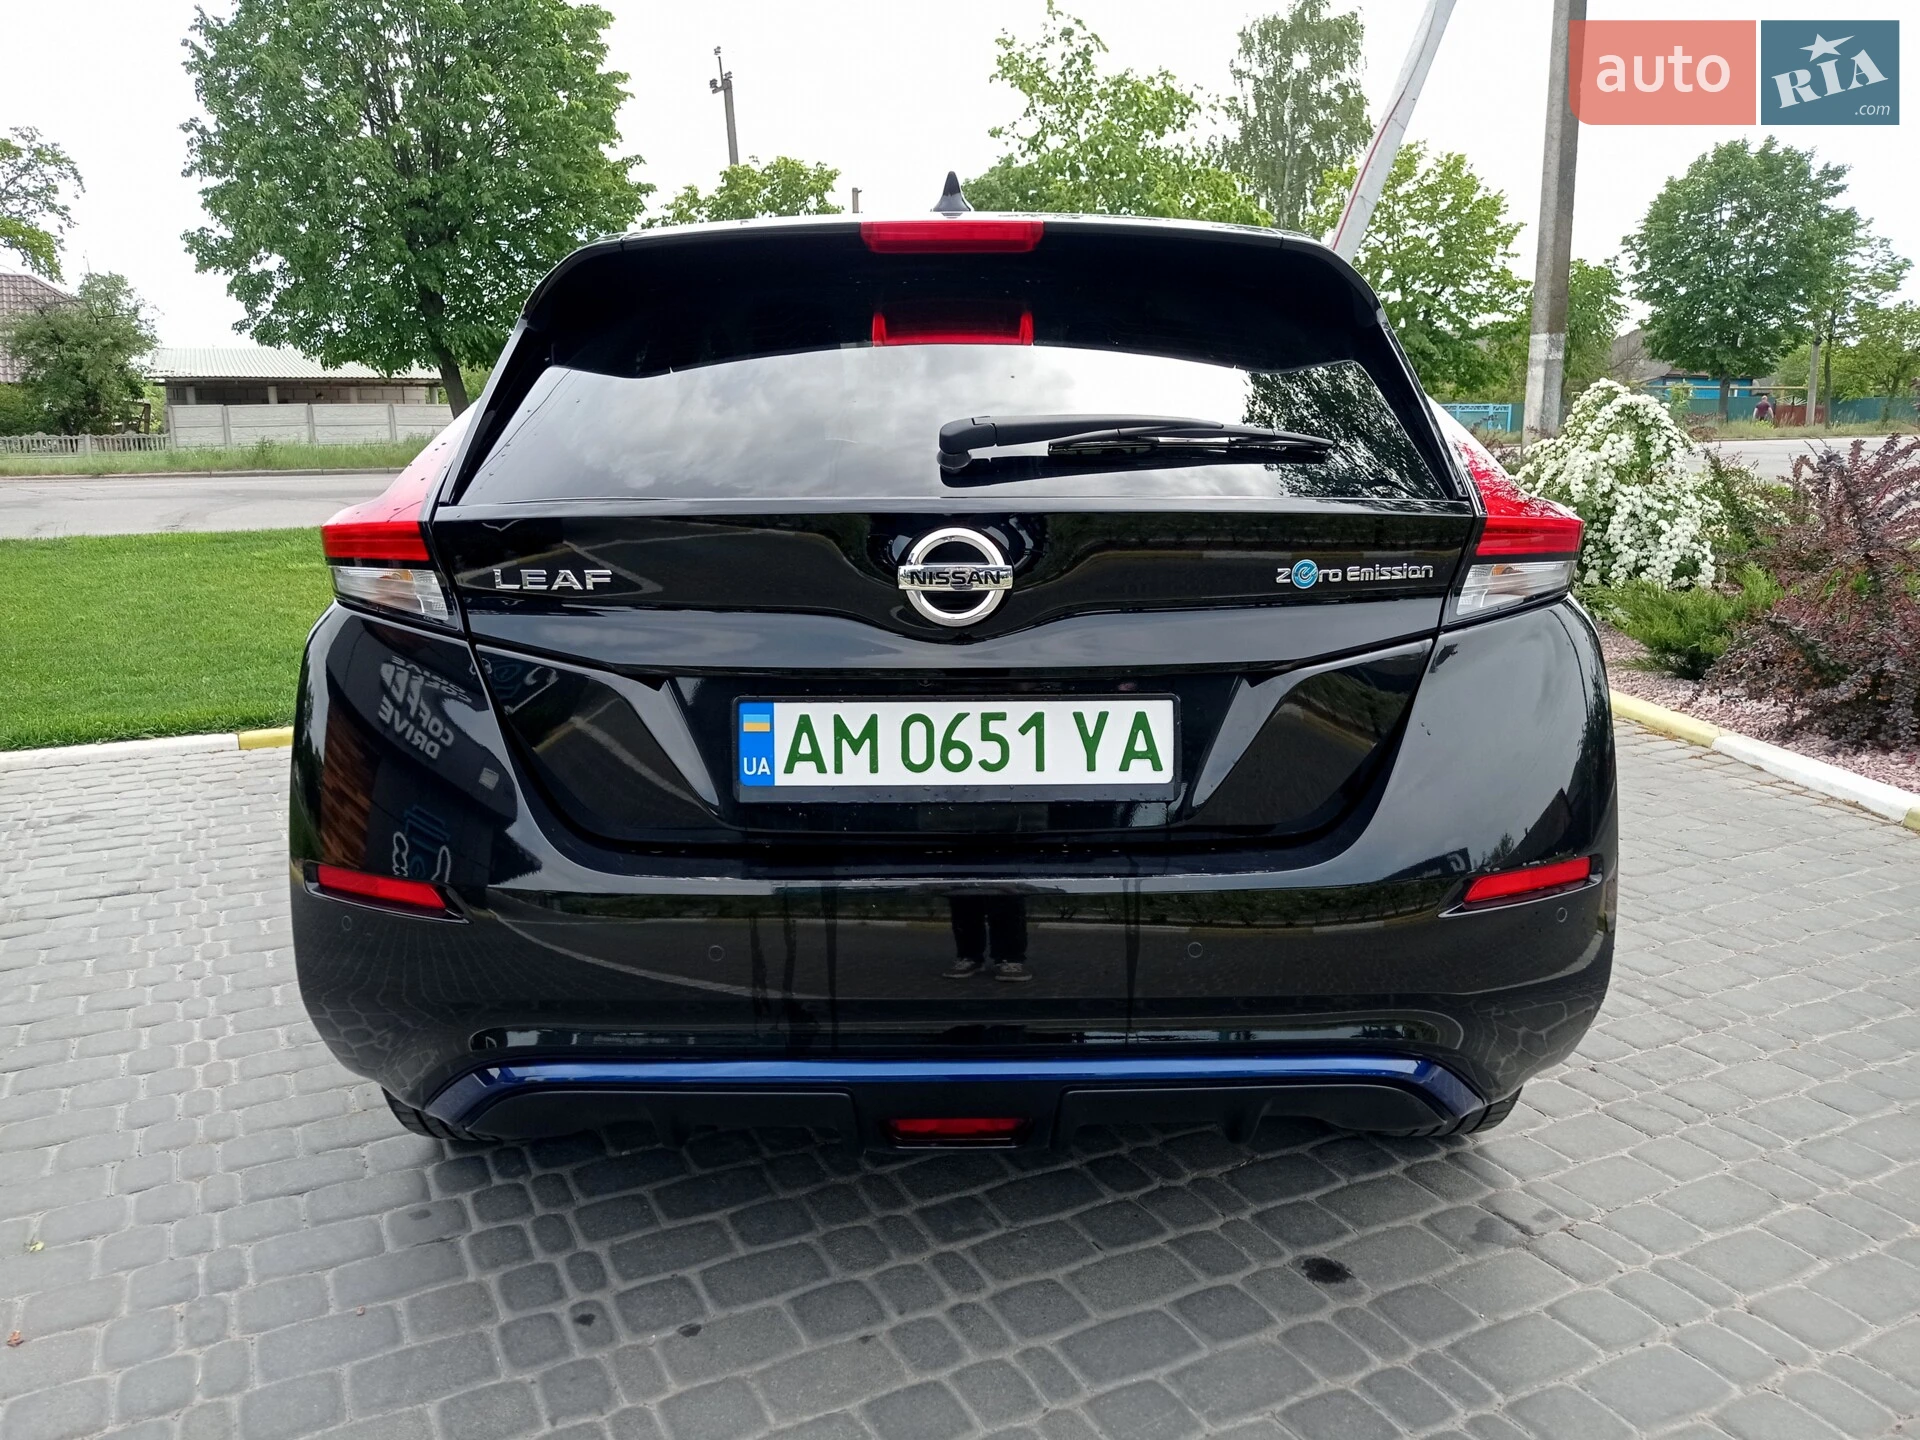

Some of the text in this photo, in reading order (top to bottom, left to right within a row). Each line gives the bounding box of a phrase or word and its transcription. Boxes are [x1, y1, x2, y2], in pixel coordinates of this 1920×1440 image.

[493, 568, 612, 590] LEAF
[910, 570, 1001, 585] NISSAN
[1346, 563, 1434, 583] Emission
[783, 711, 1164, 774] AM 0651 YA
[743, 757, 771, 776] UA
